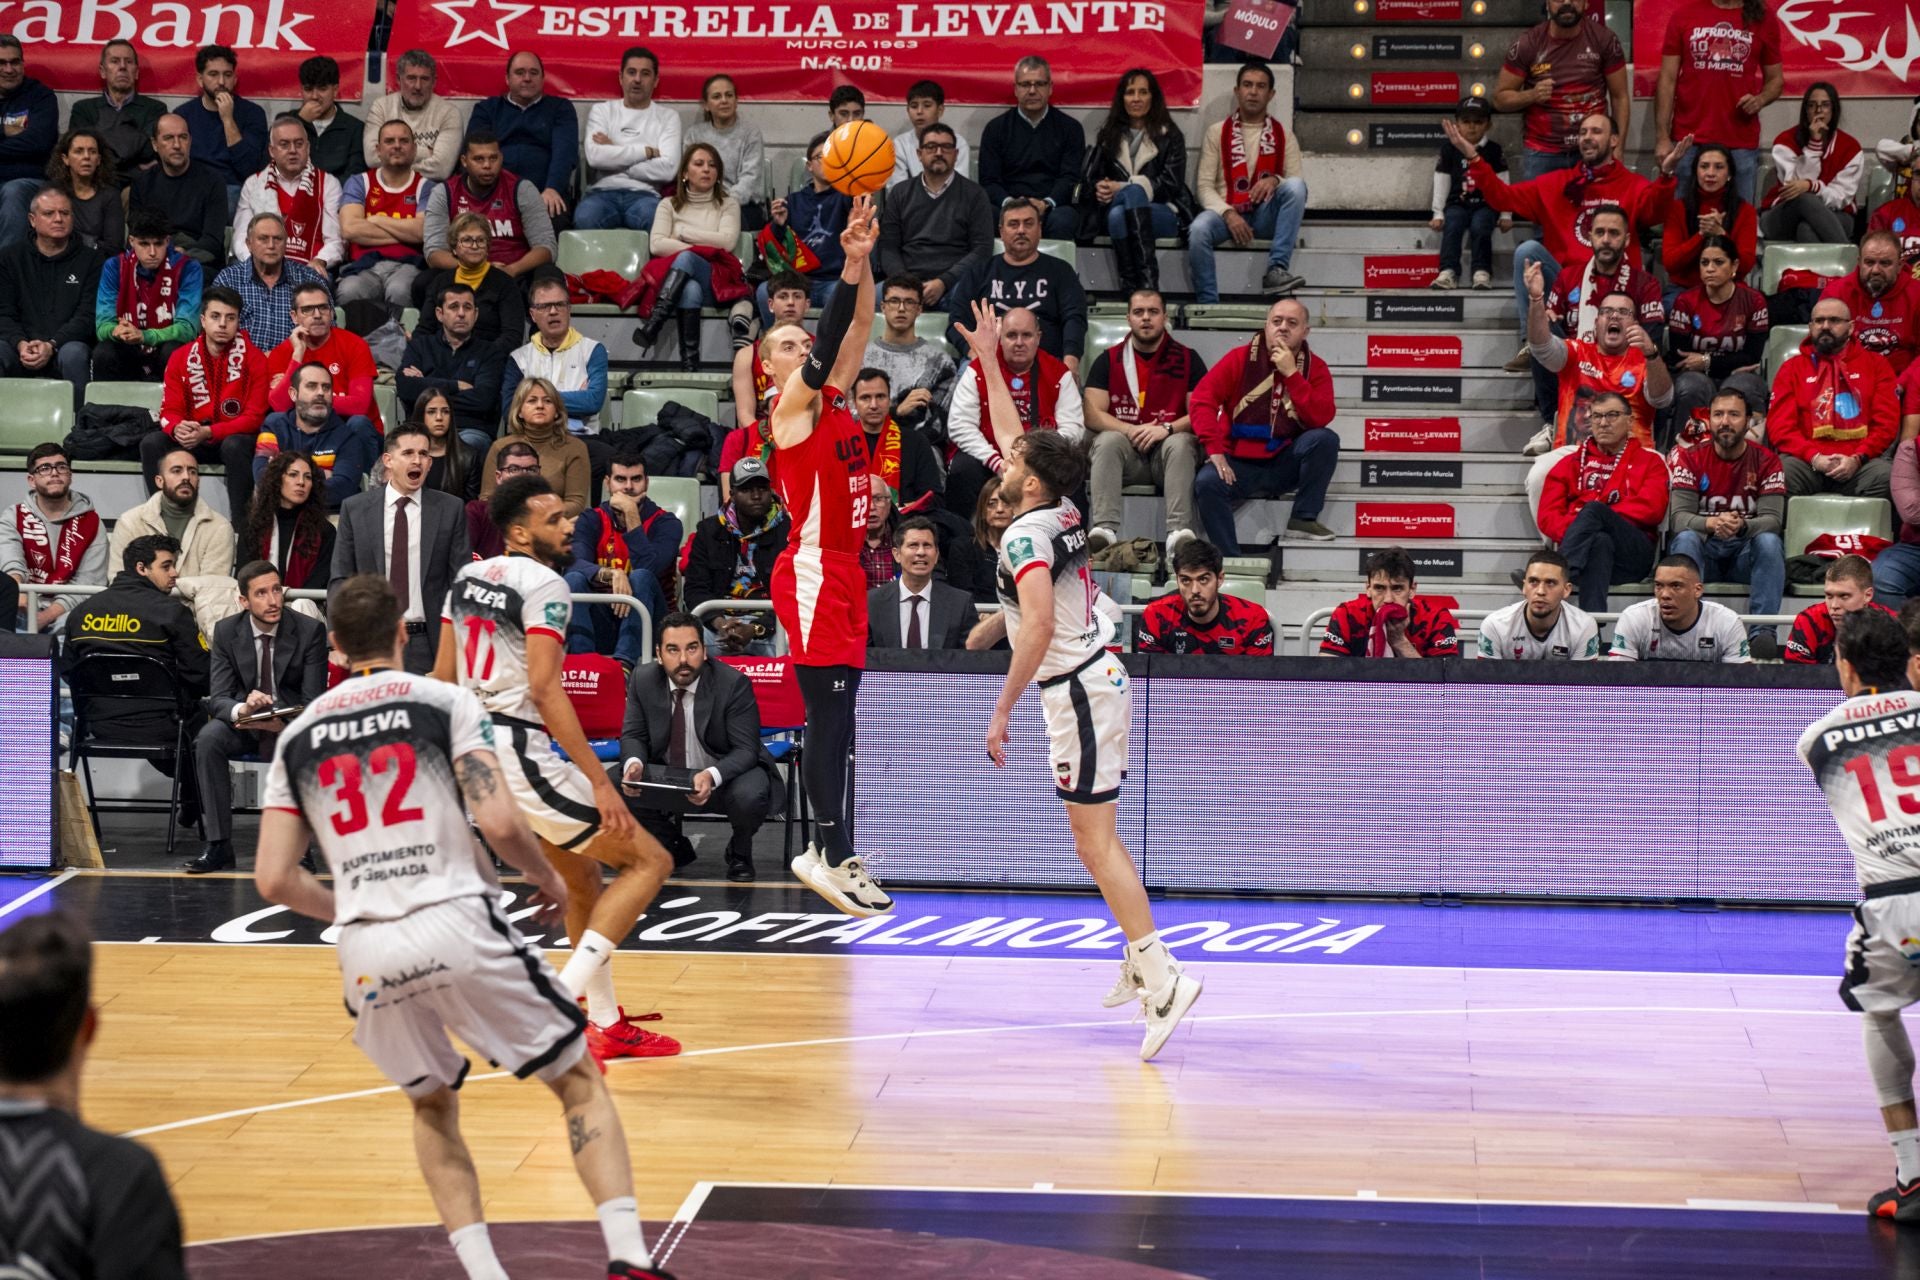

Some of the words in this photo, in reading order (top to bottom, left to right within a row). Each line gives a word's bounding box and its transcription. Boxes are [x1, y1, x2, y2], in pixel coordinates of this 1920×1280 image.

[0, 0, 315, 51] aBank
[537, 5, 842, 38] ESTRELLA
[852, 12, 889, 30] DE
[896, 2, 1165, 37] LEVANTE
[1234, 9, 1278, 31] MÓDULO
[1245, 29, 1254, 40] 9
[786, 40, 868, 49] MURCIA
[873, 40, 918, 49] 1963
[1708, 61, 1744, 72] MURCIA
[1379, 267, 1417, 275] ESTRELLA
[990, 278, 1049, 299] N.Y.C
[1386, 305, 1426, 313] Ayuntamiento
[1641, 301, 1664, 315] UCA
[1669, 309, 1691, 324] CAM
[1382, 347, 1420, 355] ESTRELLA
[1425, 347, 1459, 355] LEVANTE
[1382, 385, 1423, 393] Ayuntamiento
[1381, 469, 1423, 477] Ayuntamiento
[851, 495, 867, 529] 22
[81, 613, 141, 633] Salzillo
[745, 663, 785, 673] UCAM
[561, 681, 598, 689] NIVERSIDAD
[314, 681, 413, 715] GUERRERO
[310, 709, 412, 750] PULEVA
[317, 741, 425, 837] 32
[1844, 744, 1920, 824] 19
